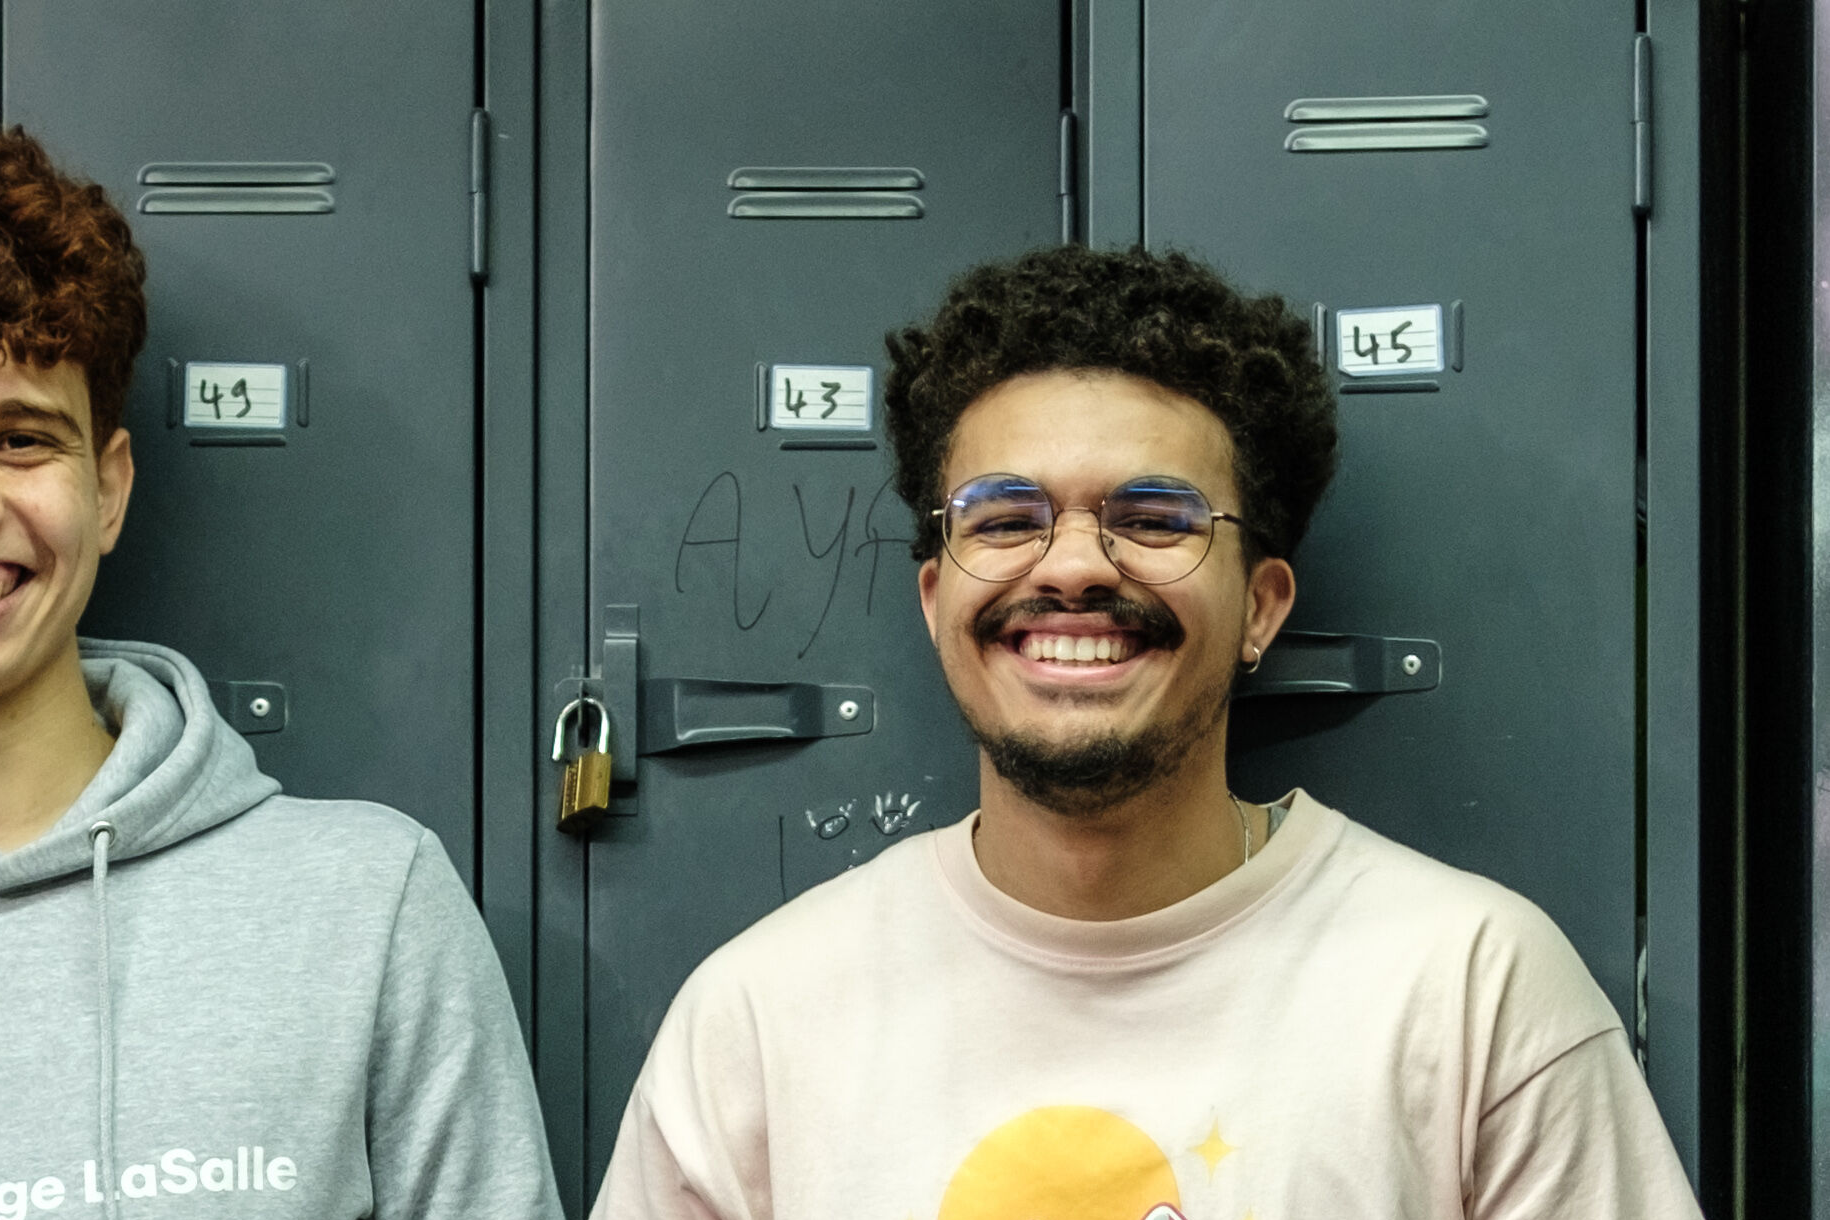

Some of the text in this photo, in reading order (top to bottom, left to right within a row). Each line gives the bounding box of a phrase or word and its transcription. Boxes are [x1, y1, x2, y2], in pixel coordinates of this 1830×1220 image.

[1354, 321, 1412, 365] 45
[200, 378, 252, 420] 49
[785, 377, 841, 420] 43
[84, 1146, 298, 1204] LaSalle
